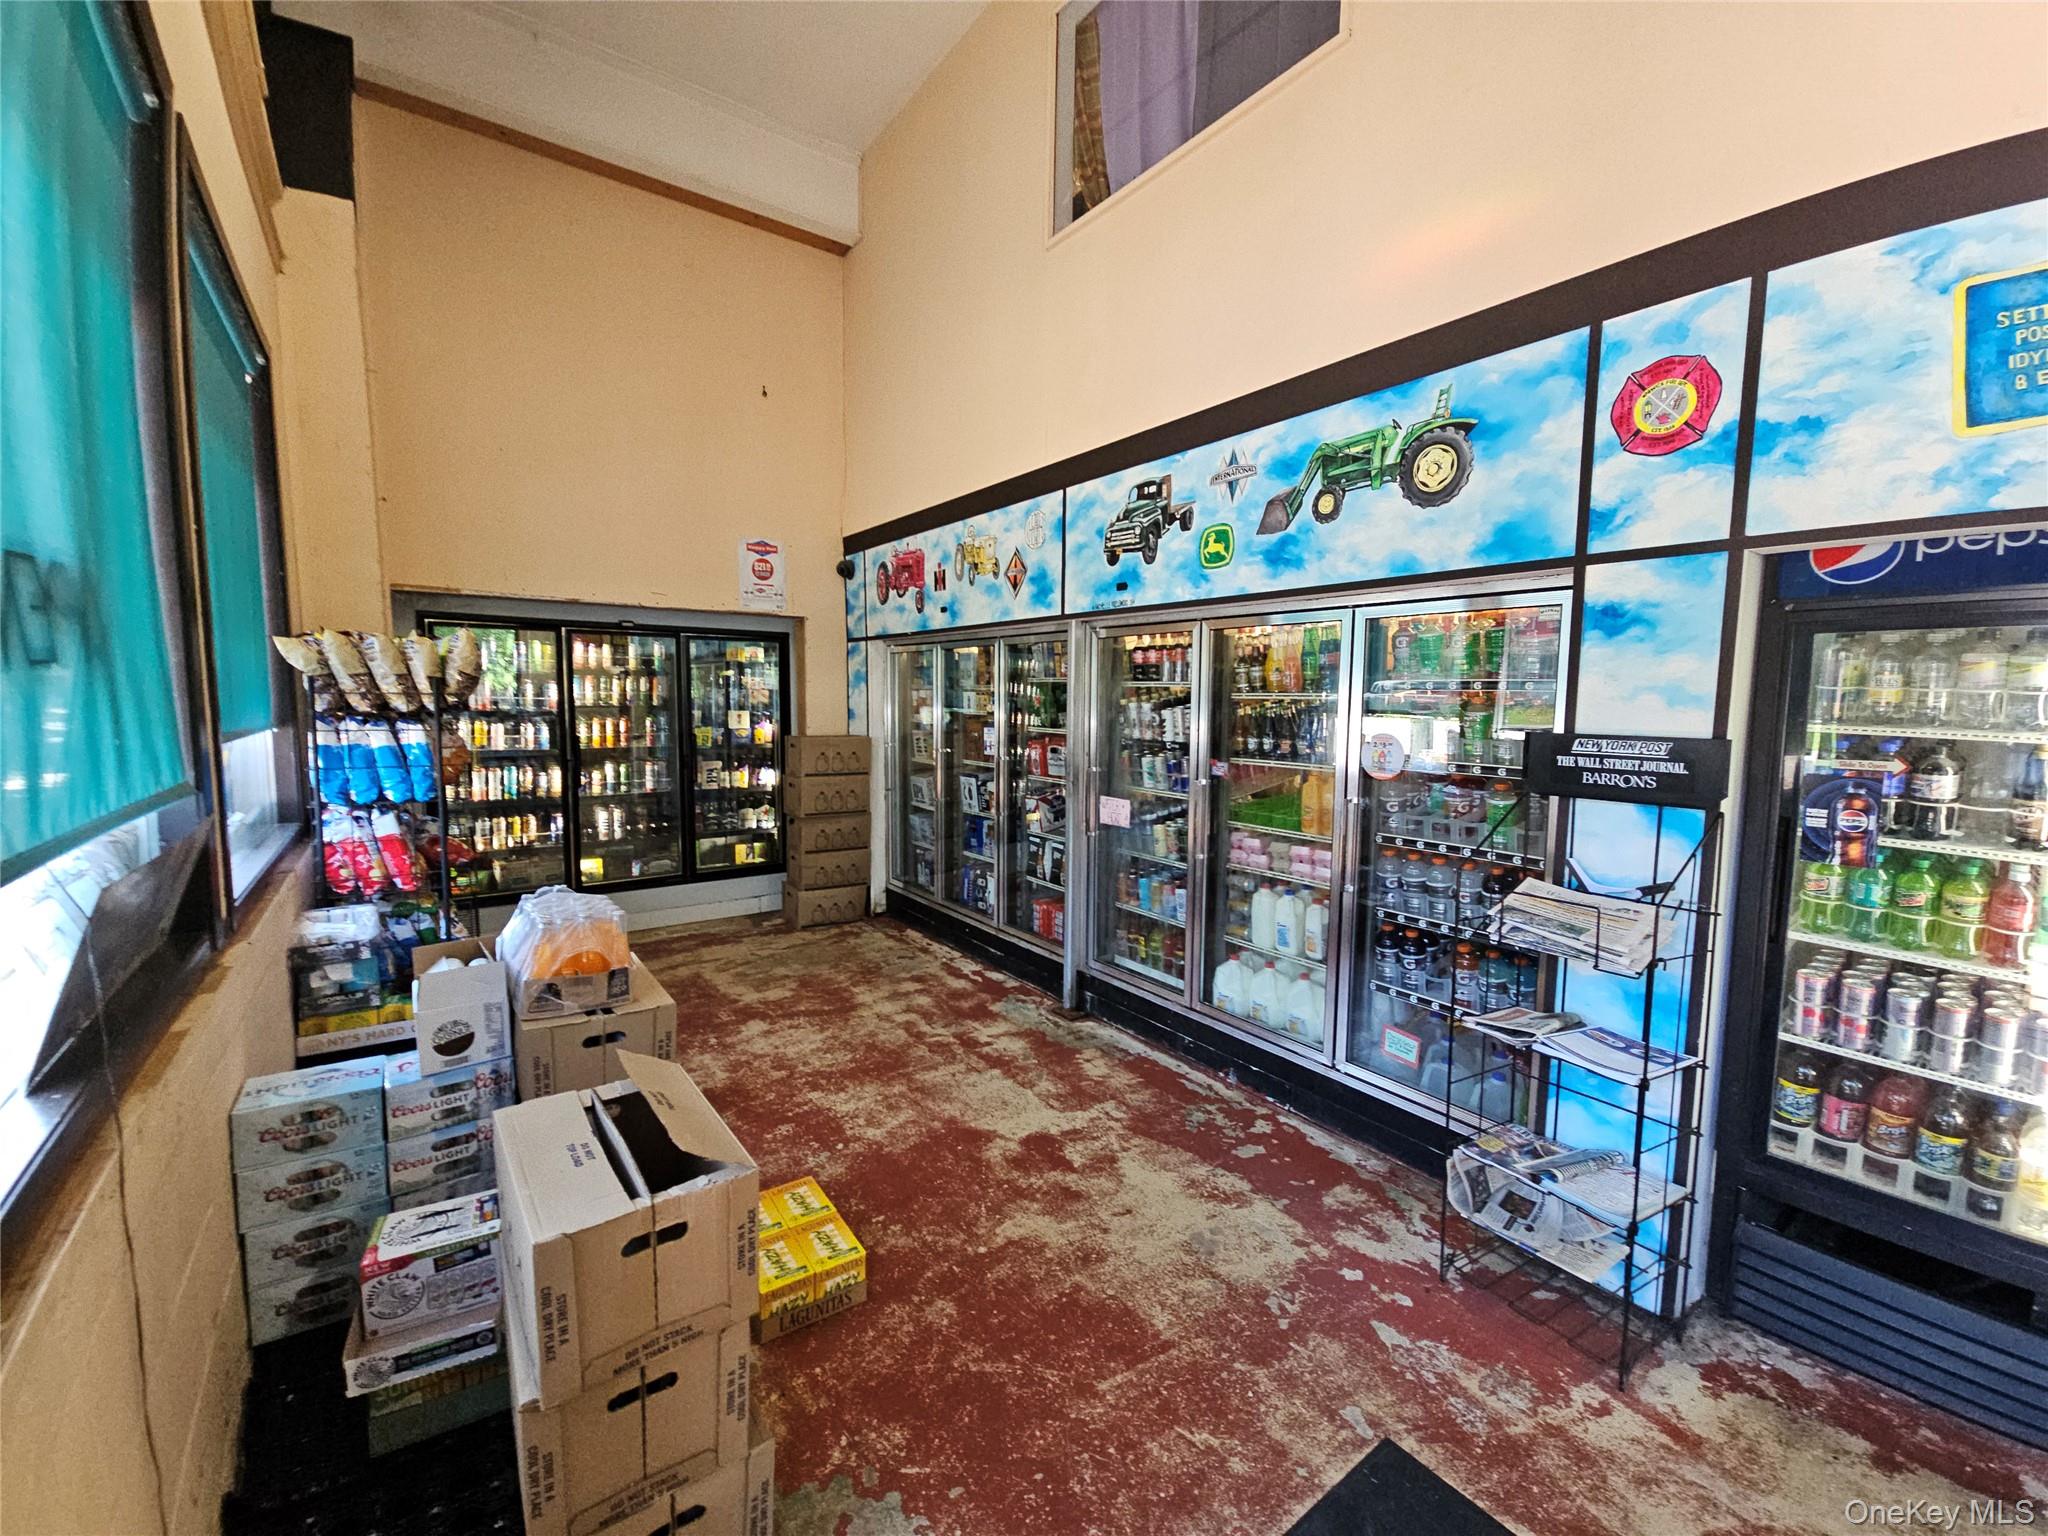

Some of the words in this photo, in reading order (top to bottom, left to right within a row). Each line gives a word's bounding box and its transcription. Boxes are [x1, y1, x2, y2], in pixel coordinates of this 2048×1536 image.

[1211, 463, 1257, 485] INTERNATIONAL
[1575, 738, 1602, 751] NEW
[1604, 739, 1637, 753] YORK
[1638, 741, 1672, 755] POST
[1556, 756, 1575, 767] THE
[1577, 756, 1602, 768] WALL
[1603, 758, 1641, 771] STREET
[1582, 771, 1657, 789] BARRON'S
[365, 1026, 405, 1042] HARD
[391, 1103, 432, 1118] Coors
[433, 1093, 470, 1108] LIGHT
[258, 1125, 310, 1142] Coors
[313, 1115, 359, 1132] LIGHT
[392, 1156, 433, 1173] Coors
[434, 1146, 471, 1162] LIGHT
[262, 1182, 315, 1202] Coors
[366, 1280, 385, 1309] WHITE
[387, 1272, 420, 1281] CLAW
[540, 1286, 552, 1311] COOL
[555, 1293, 568, 1324] STORE
[780, 1293, 852, 1333] LAGUNITAS
[542, 1312, 554, 1332] DRY
[557, 1325, 569, 1338] IN
[544, 1333, 557, 1364] PLACE
[559, 1338, 570, 1346] A
[641, 1337, 660, 1351] NOT
[663, 1324, 693, 1341] STACK
[645, 1343, 670, 1360] THAN
[527, 1445, 539, 1472] COOL
[543, 1451, 554, 1481] STORE
[528, 1471, 540, 1490] DRY
[543, 1481, 555, 1494] IN
[530, 1490, 543, 1520] PLACE
[544, 1495, 556, 1503] A
